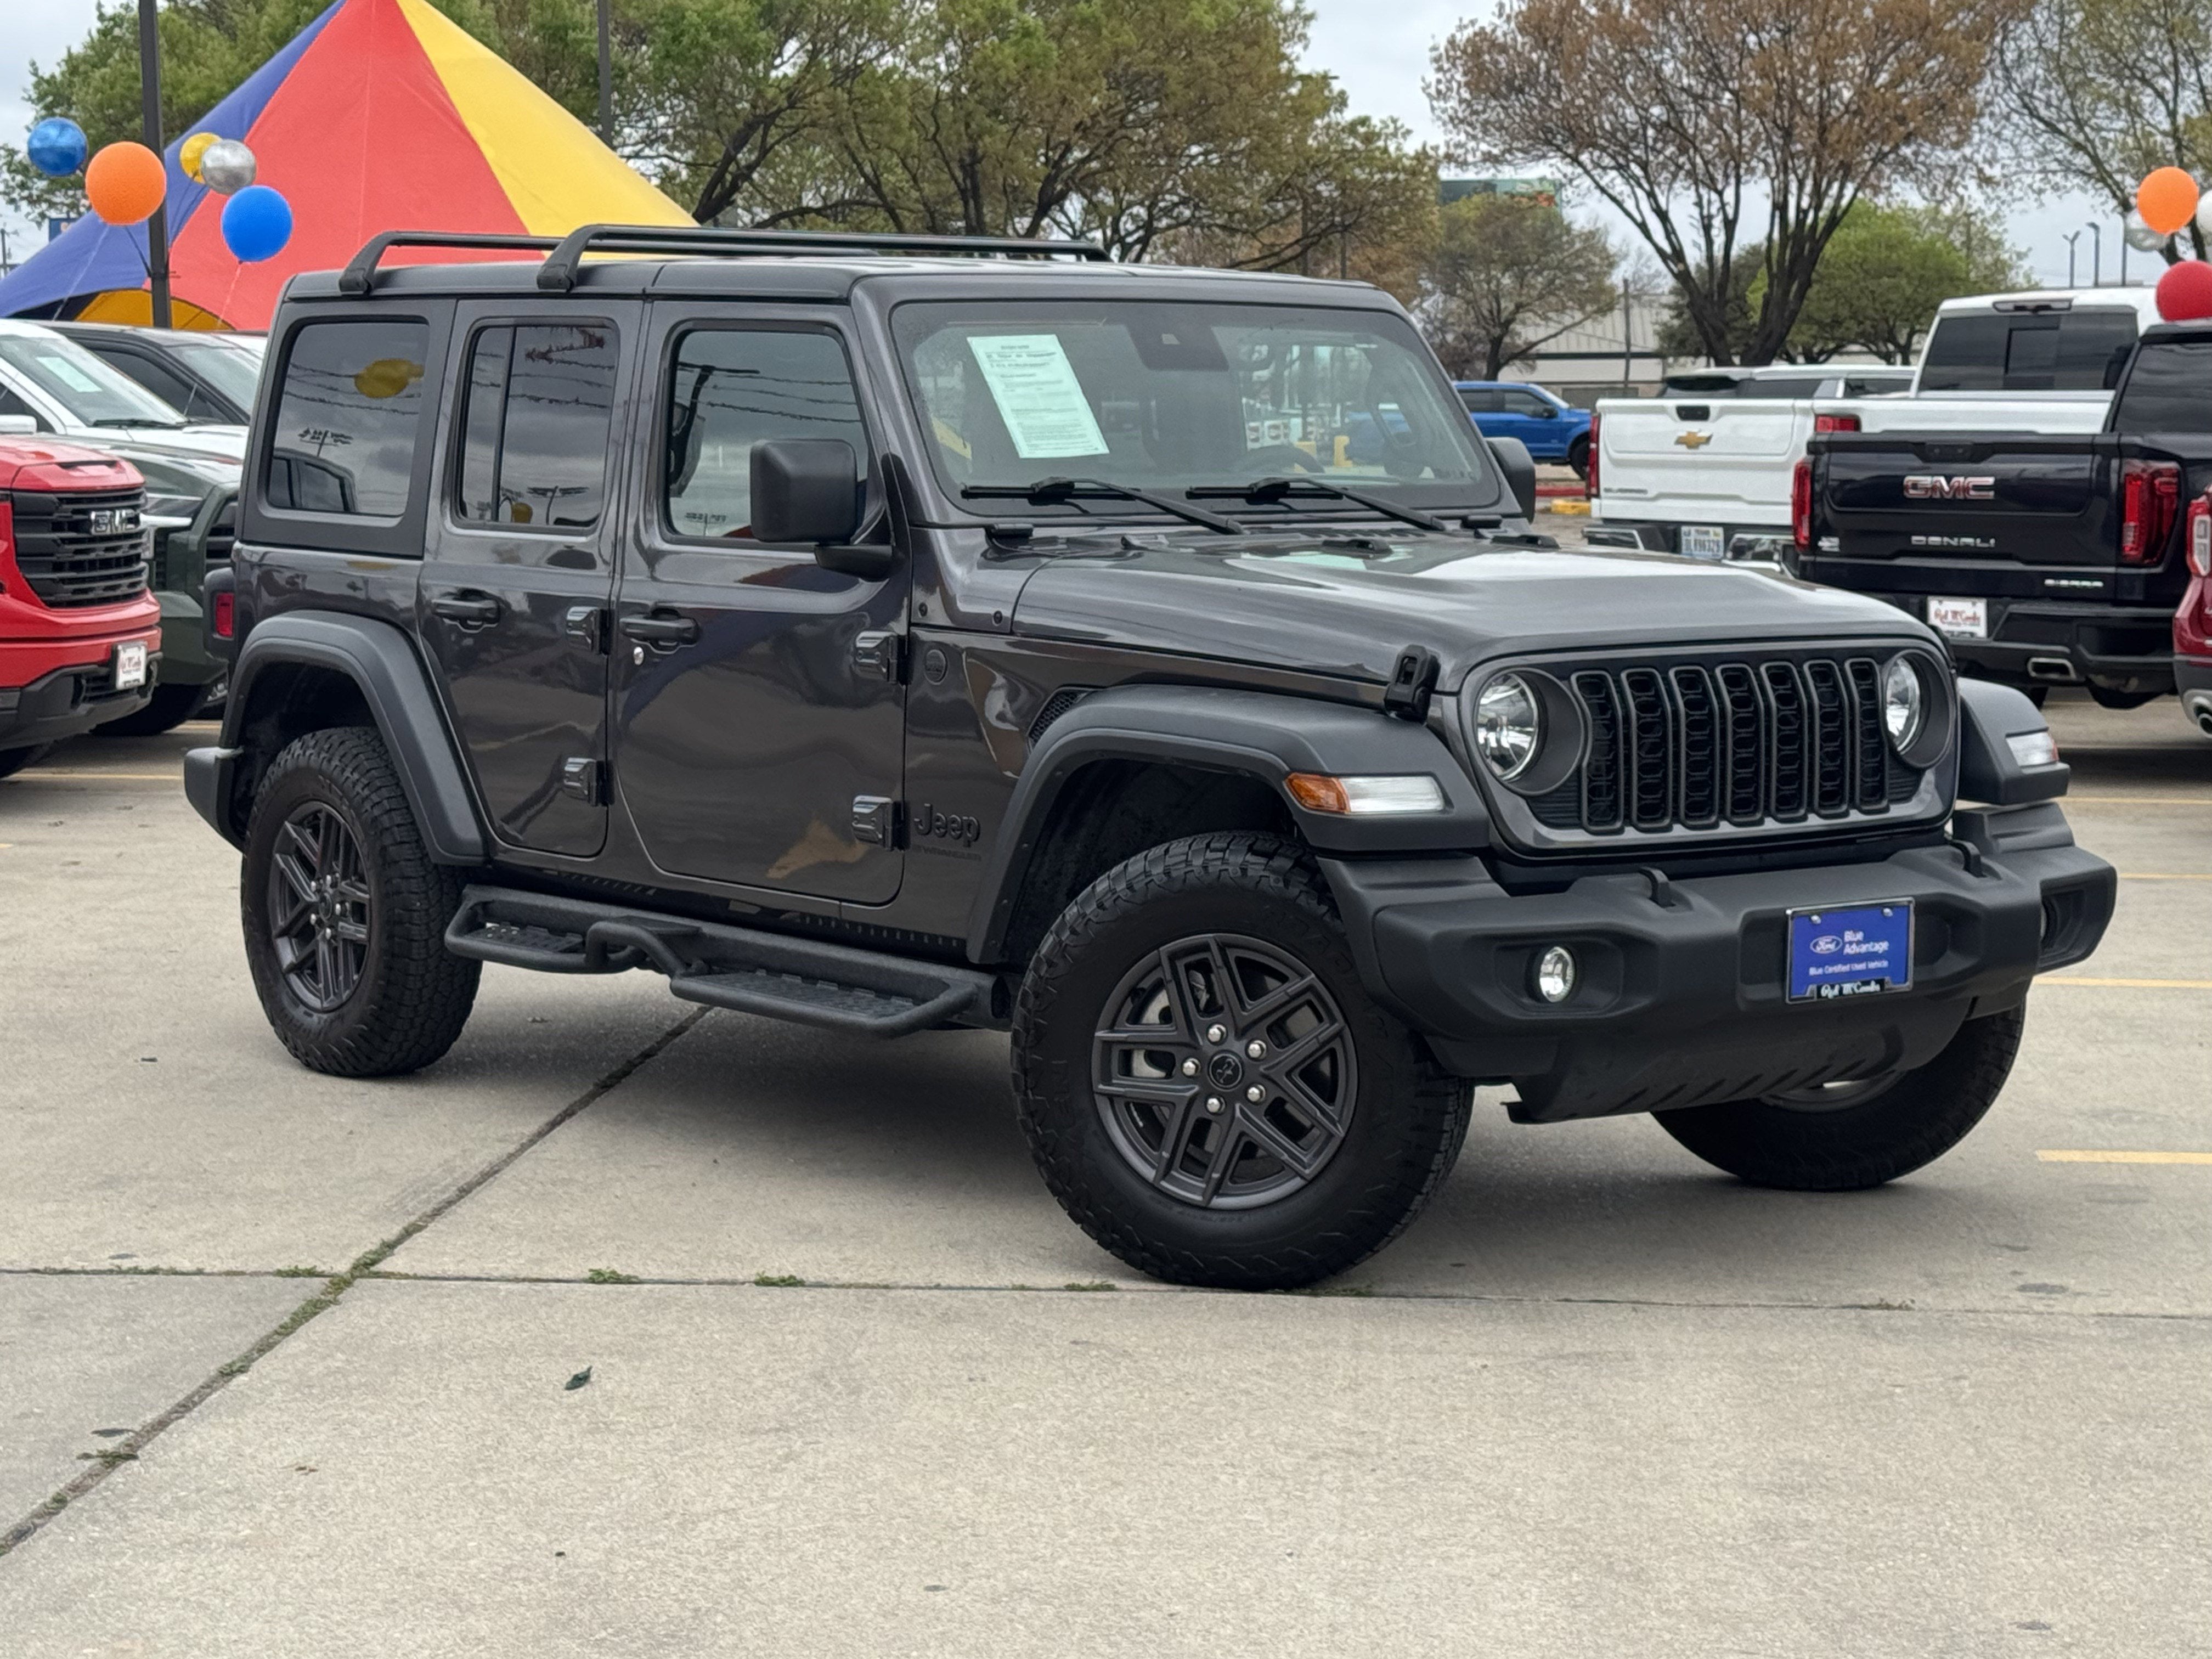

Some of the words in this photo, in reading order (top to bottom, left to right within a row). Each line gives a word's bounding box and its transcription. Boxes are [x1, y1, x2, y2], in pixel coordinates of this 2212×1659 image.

[1903, 475, 1995, 499] GMC
[91, 509, 140, 535] GMC
[1911, 535, 1995, 548] DENALI
[914, 803, 981, 848] Jeep
[1844, 930, 1864, 942] Blue
[1815, 938, 1837, 952] Ford
[1843, 941, 1889, 955] Advantage
